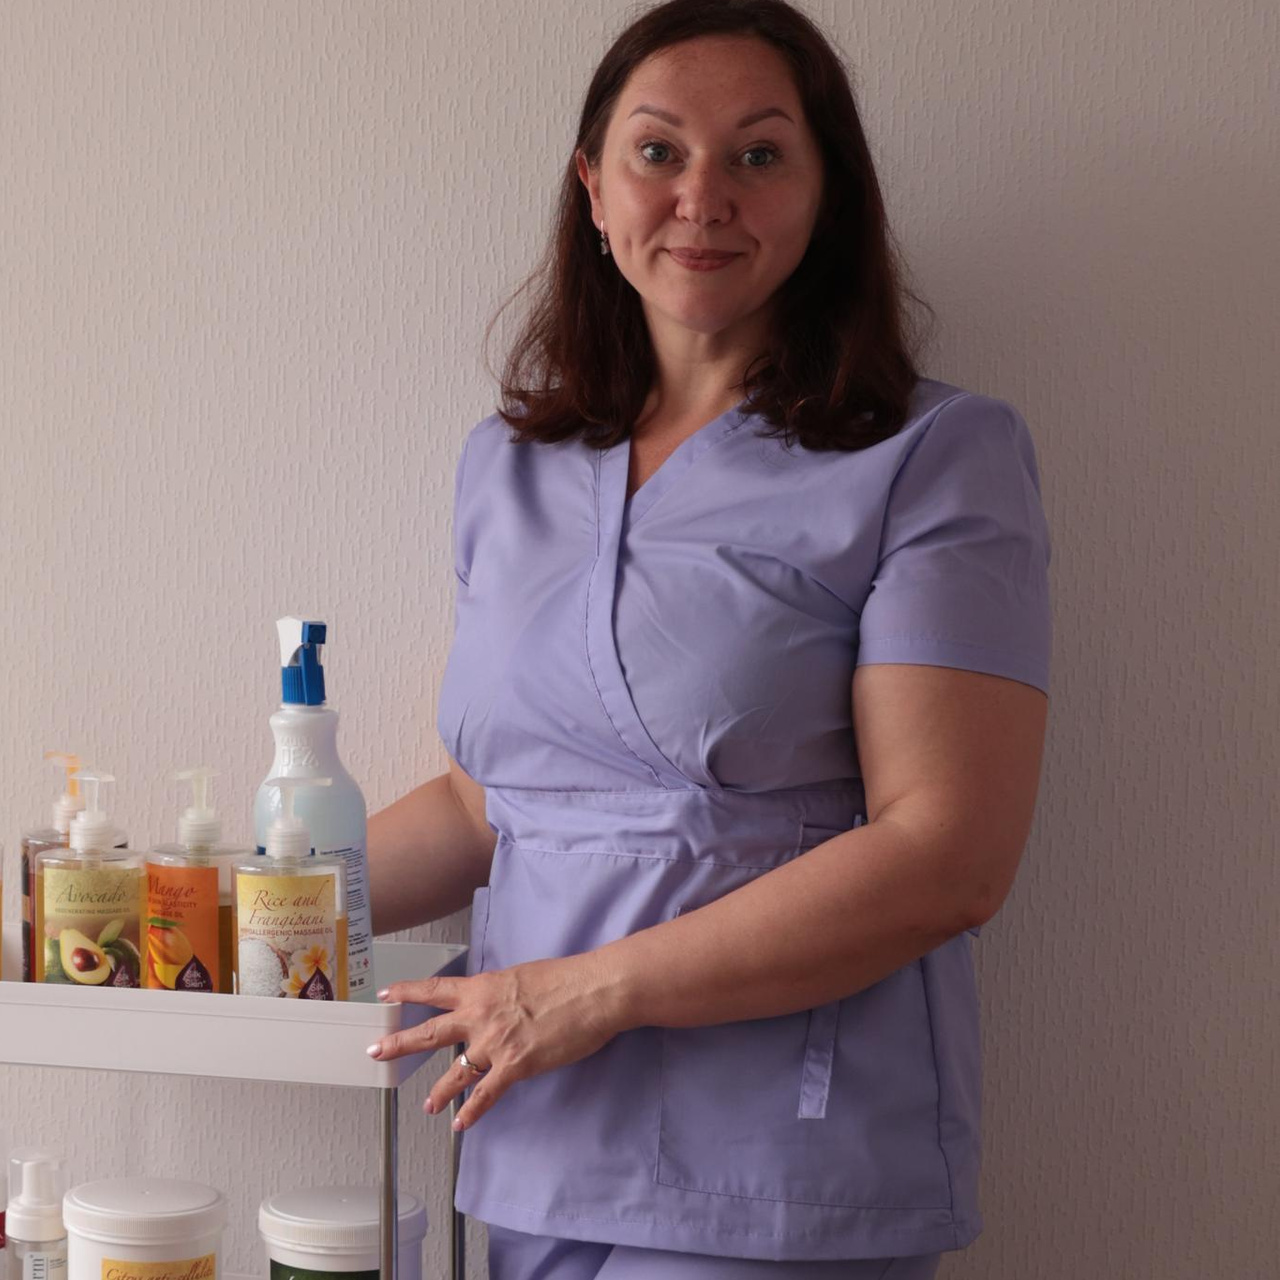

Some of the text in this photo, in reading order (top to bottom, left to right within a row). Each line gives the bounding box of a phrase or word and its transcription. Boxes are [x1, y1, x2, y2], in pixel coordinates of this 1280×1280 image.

[55, 873, 129, 904] Avocado
[253, 889, 288, 911] Rice
[292, 879, 330, 907] and
[249, 908, 326, 935] Frangipani
[293, 927, 323, 937] MASSAGE
